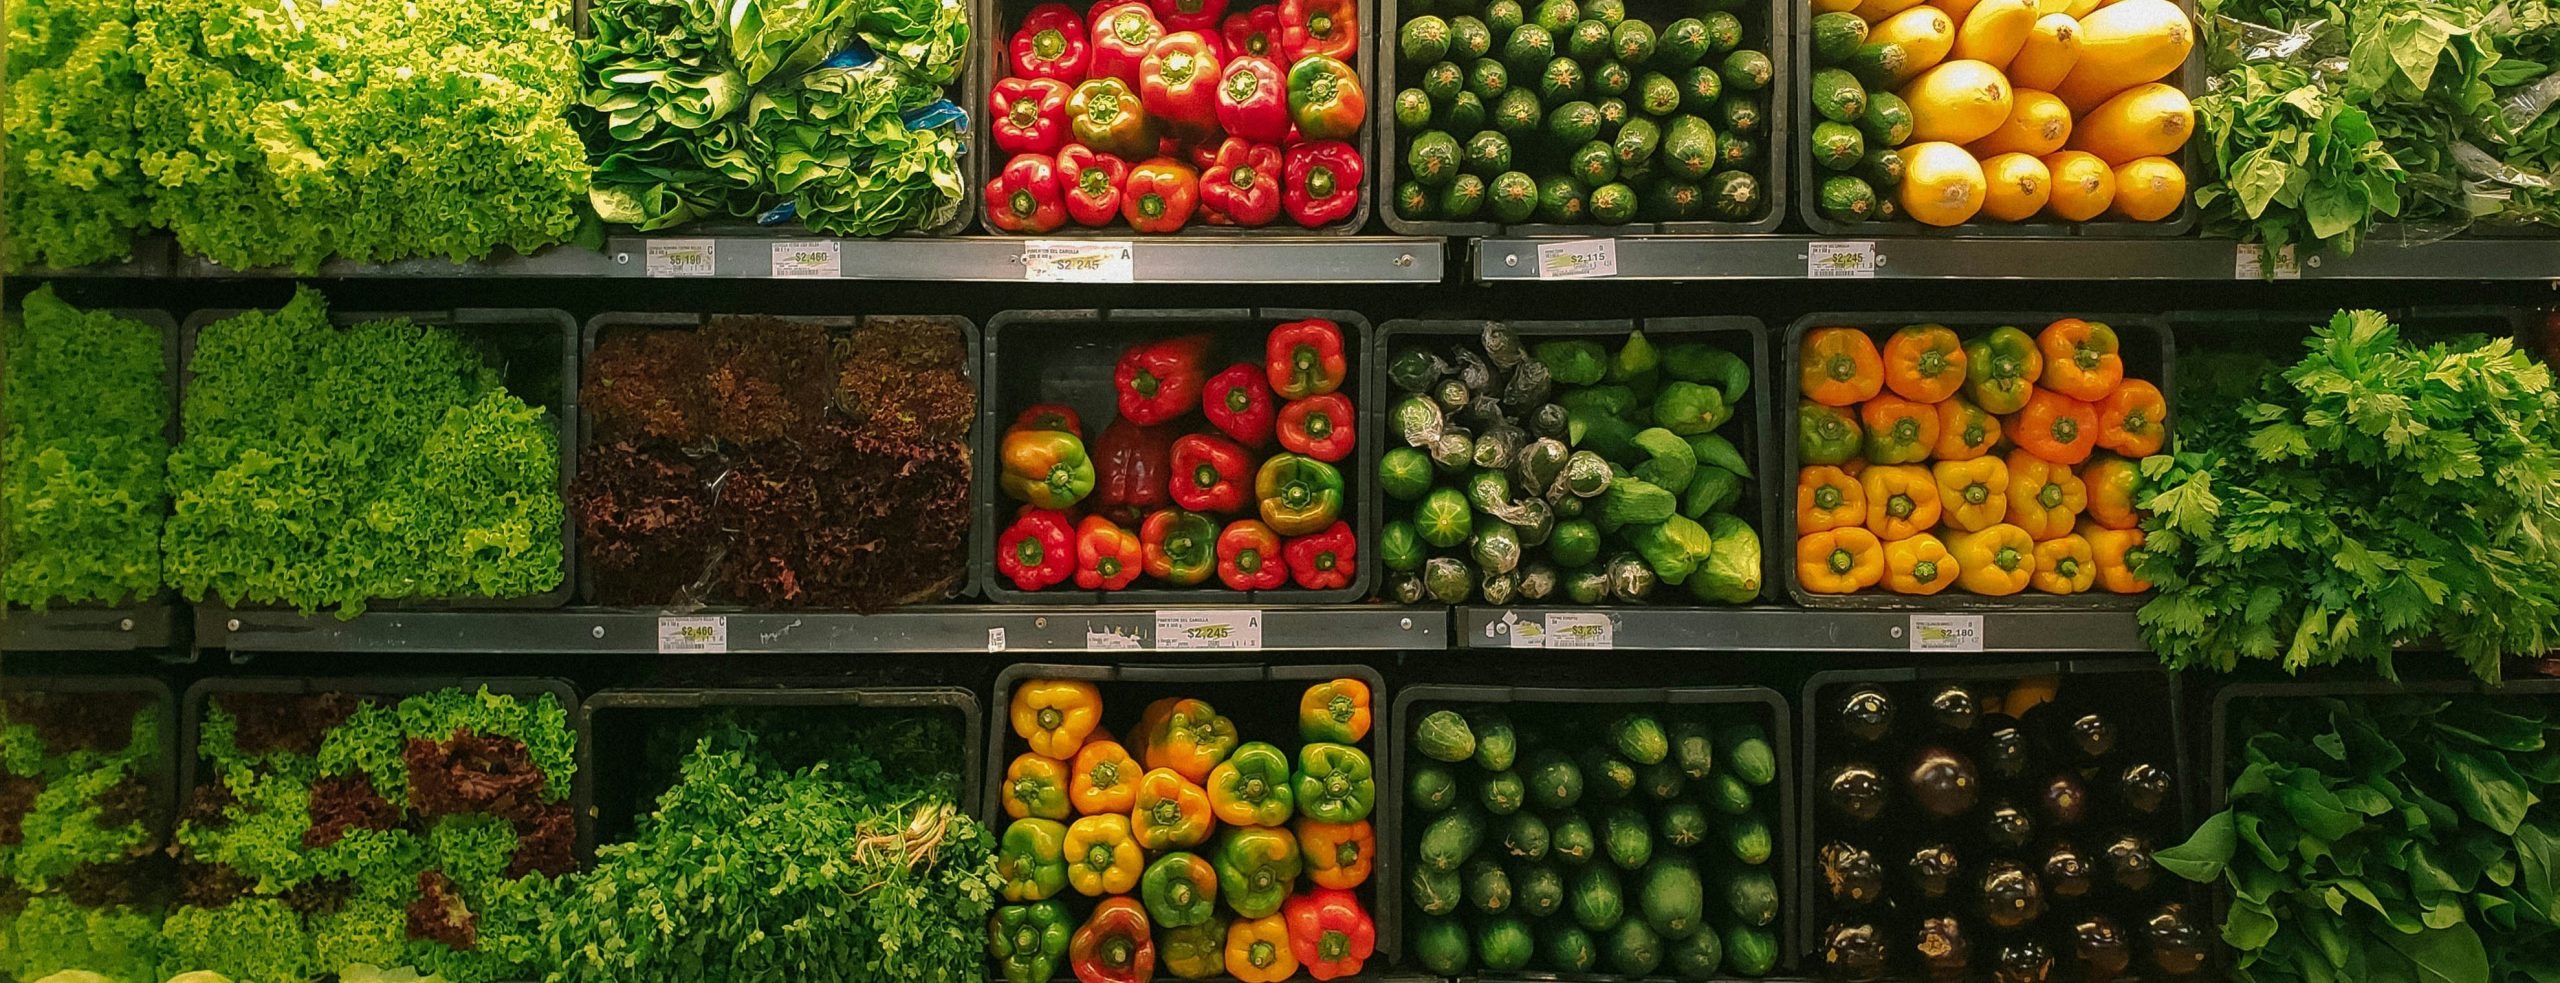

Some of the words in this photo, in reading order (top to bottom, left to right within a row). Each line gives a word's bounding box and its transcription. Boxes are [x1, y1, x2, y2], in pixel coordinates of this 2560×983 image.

[833, 242, 839, 252] C
[1869, 243, 1875, 253] A
[795, 252, 827, 263] $2,460
[1120, 248, 1130, 259] A
[1832, 252, 1863, 264] $2,245
[719, 616, 724, 626] C
[1249, 617, 1258, 627] A
[681, 626, 713, 637] $2,460
[1187, 627, 1228, 639] $2,245
